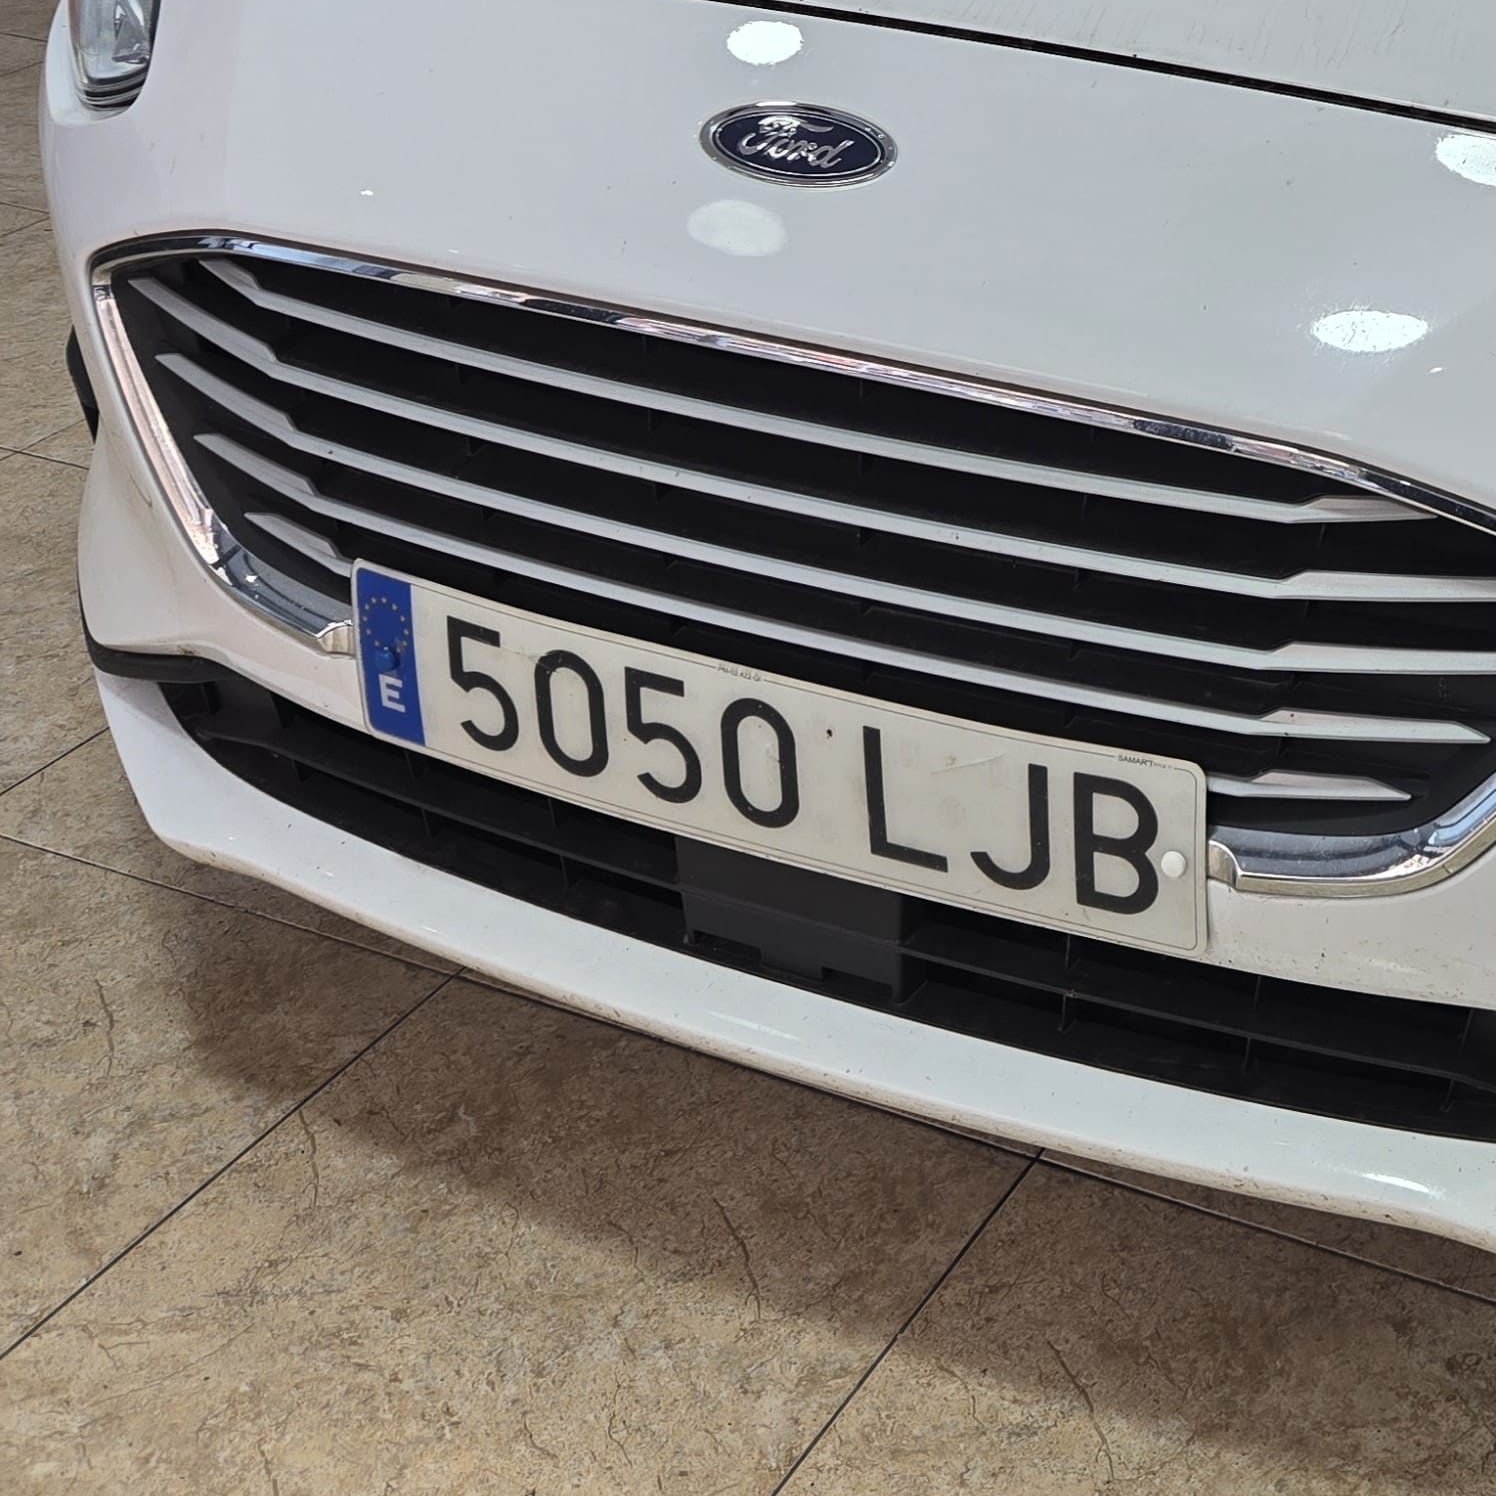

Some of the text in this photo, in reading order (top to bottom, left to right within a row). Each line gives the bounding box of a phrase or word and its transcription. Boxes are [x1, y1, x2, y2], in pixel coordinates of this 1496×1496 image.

[738, 115, 855, 169] Ford
[379, 676, 408, 713] E
[446, 614, 1160, 915] 5050 LJB
